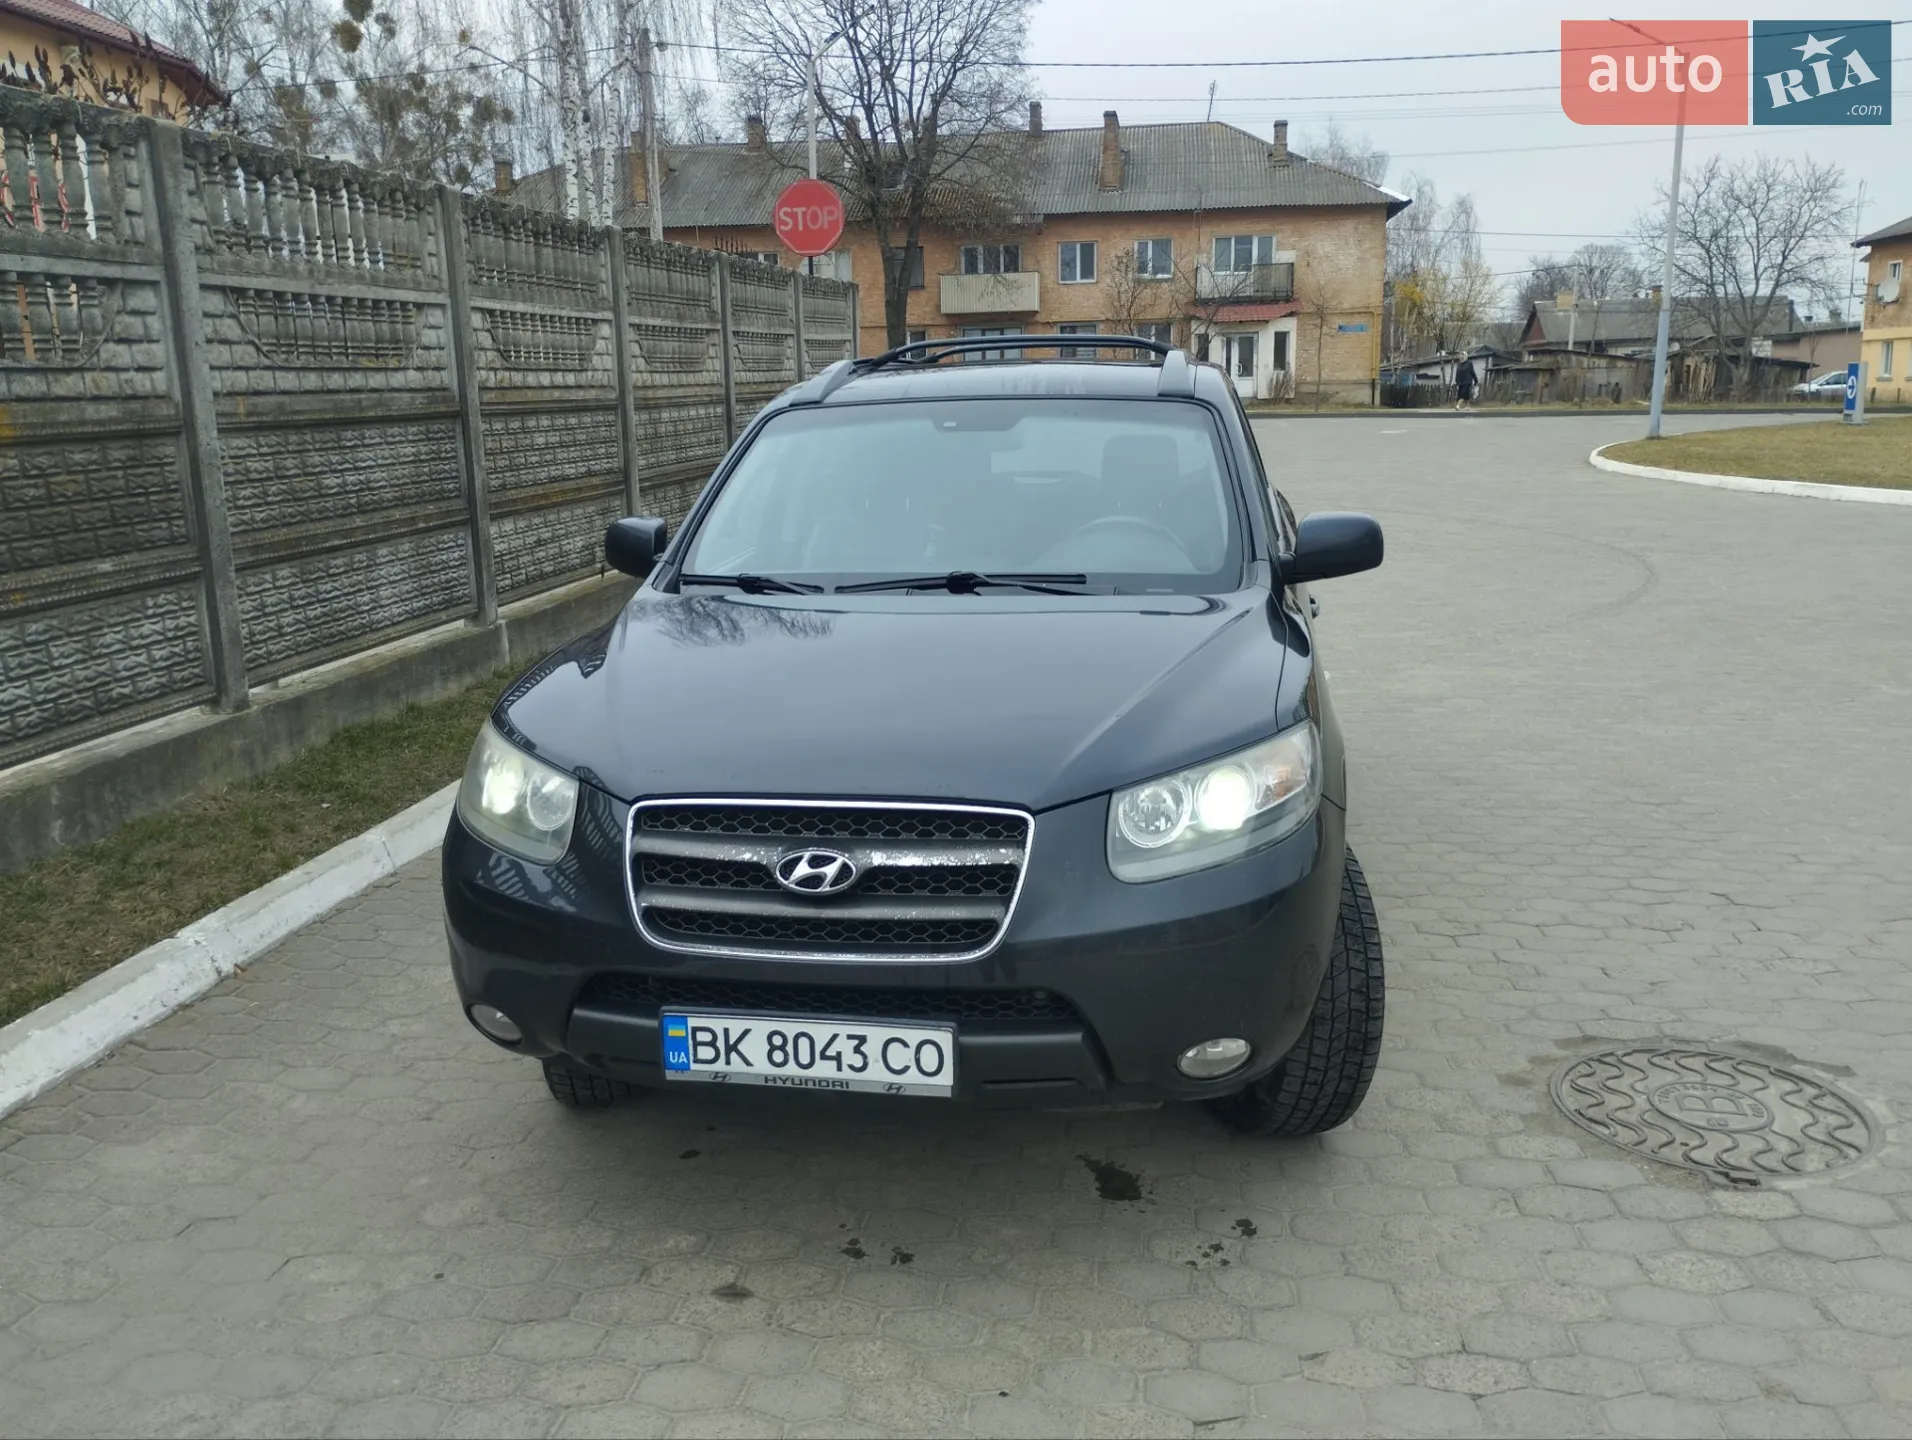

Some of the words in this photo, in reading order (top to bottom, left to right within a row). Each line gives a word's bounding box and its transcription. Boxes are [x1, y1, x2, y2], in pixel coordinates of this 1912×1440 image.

[779, 205, 839, 232] STOP
[669, 1051, 688, 1064] UA
[690, 1025, 754, 1068] BK
[766, 1029, 869, 1073] 8043
[881, 1036, 945, 1078] CO
[764, 1075, 850, 1090] HYUNDAI
